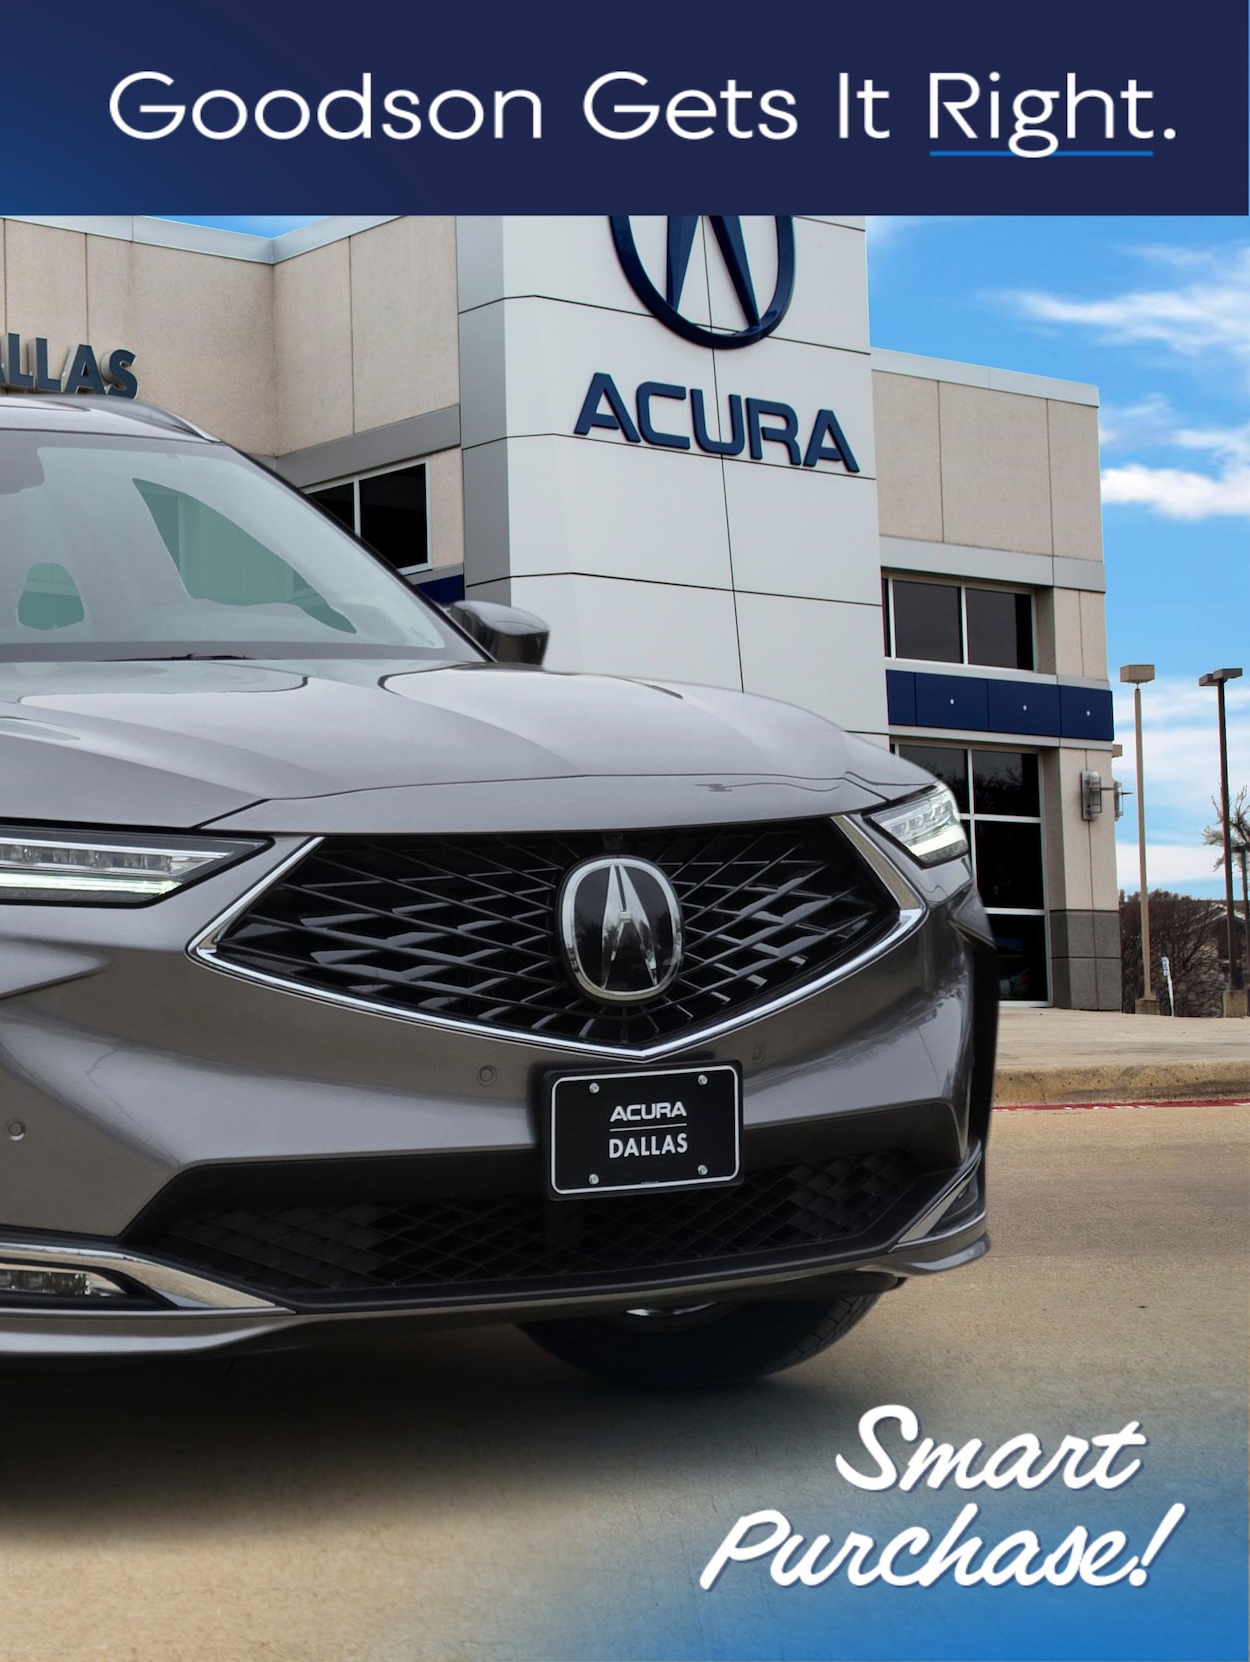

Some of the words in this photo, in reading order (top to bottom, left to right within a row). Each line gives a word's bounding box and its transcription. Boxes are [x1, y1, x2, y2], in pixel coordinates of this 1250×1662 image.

[573, 371, 861, 474] ACURA
[609, 1101, 688, 1123] ACURA
[608, 1133, 689, 1159] DALLAS
